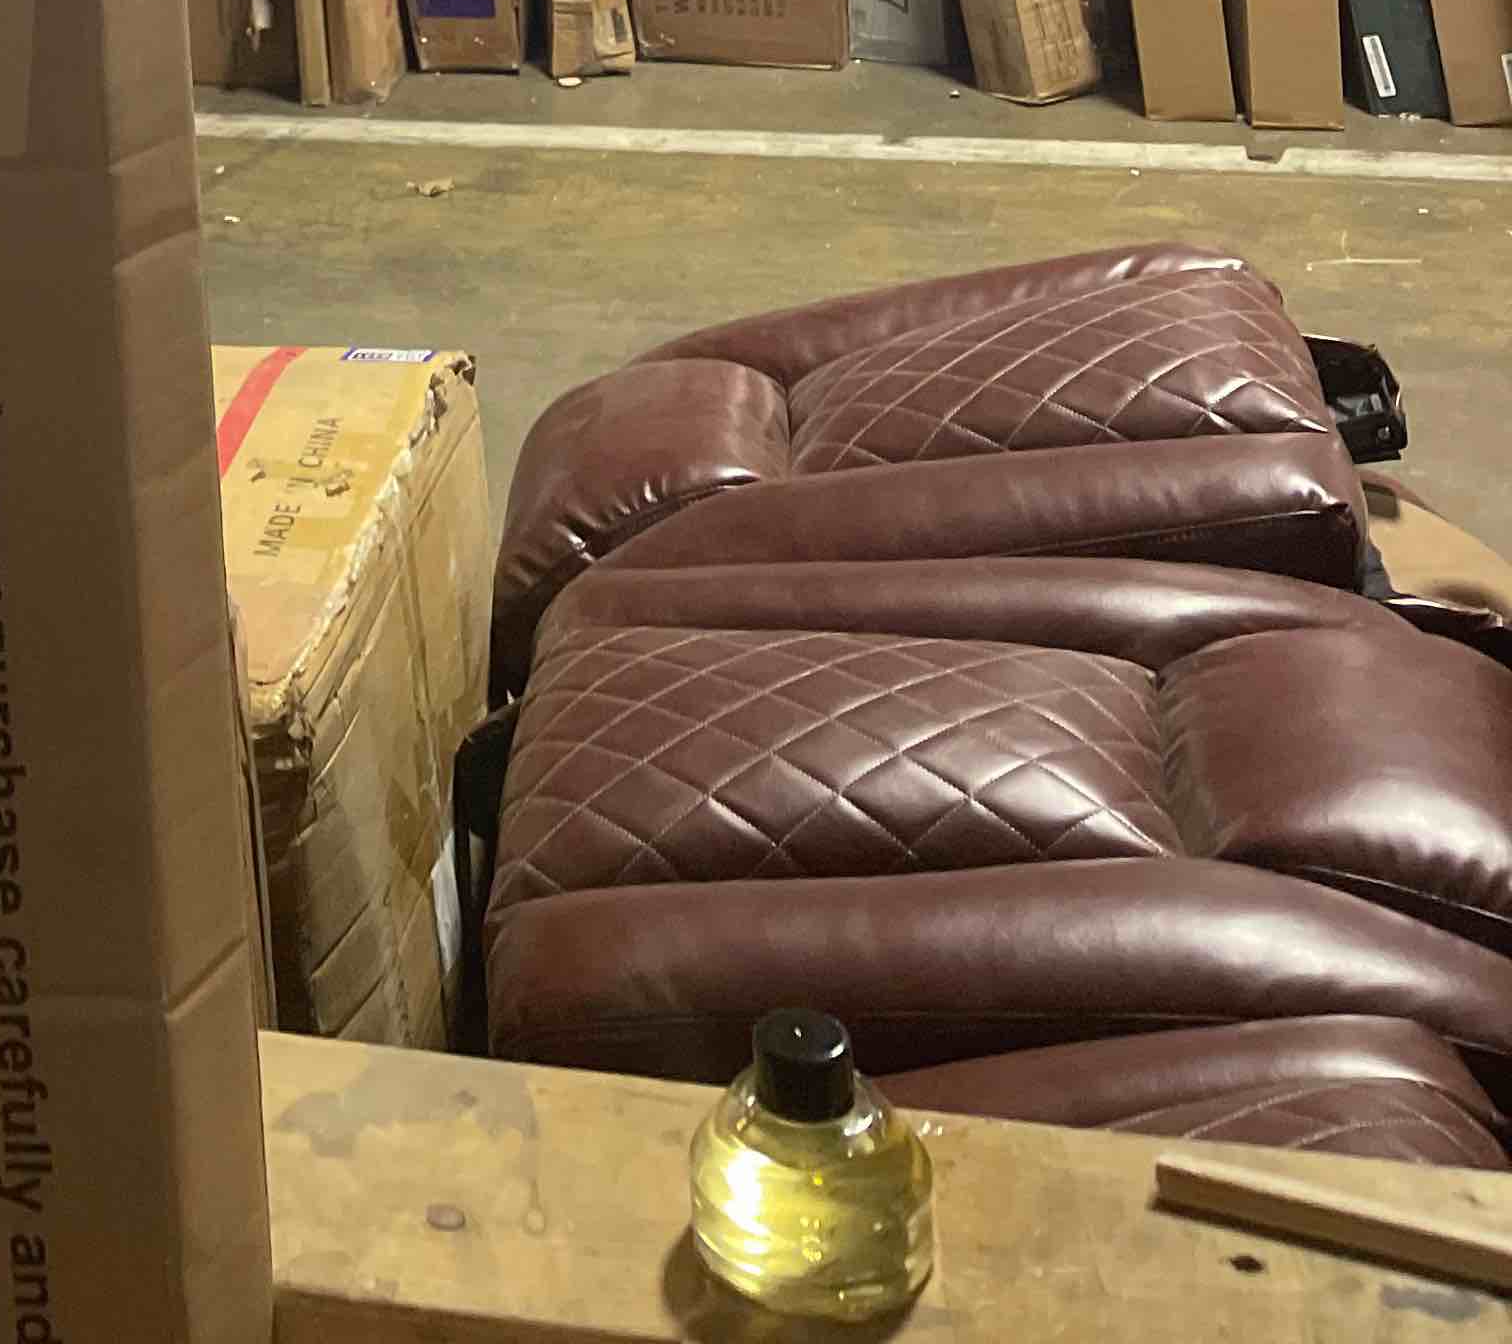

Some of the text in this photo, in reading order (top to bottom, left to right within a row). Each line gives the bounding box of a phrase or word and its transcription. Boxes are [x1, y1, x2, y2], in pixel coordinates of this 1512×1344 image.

[254, 502, 301, 558] MADE
[300, 416, 343, 472] CHINA
[10, 1237, 56, 1344] and
